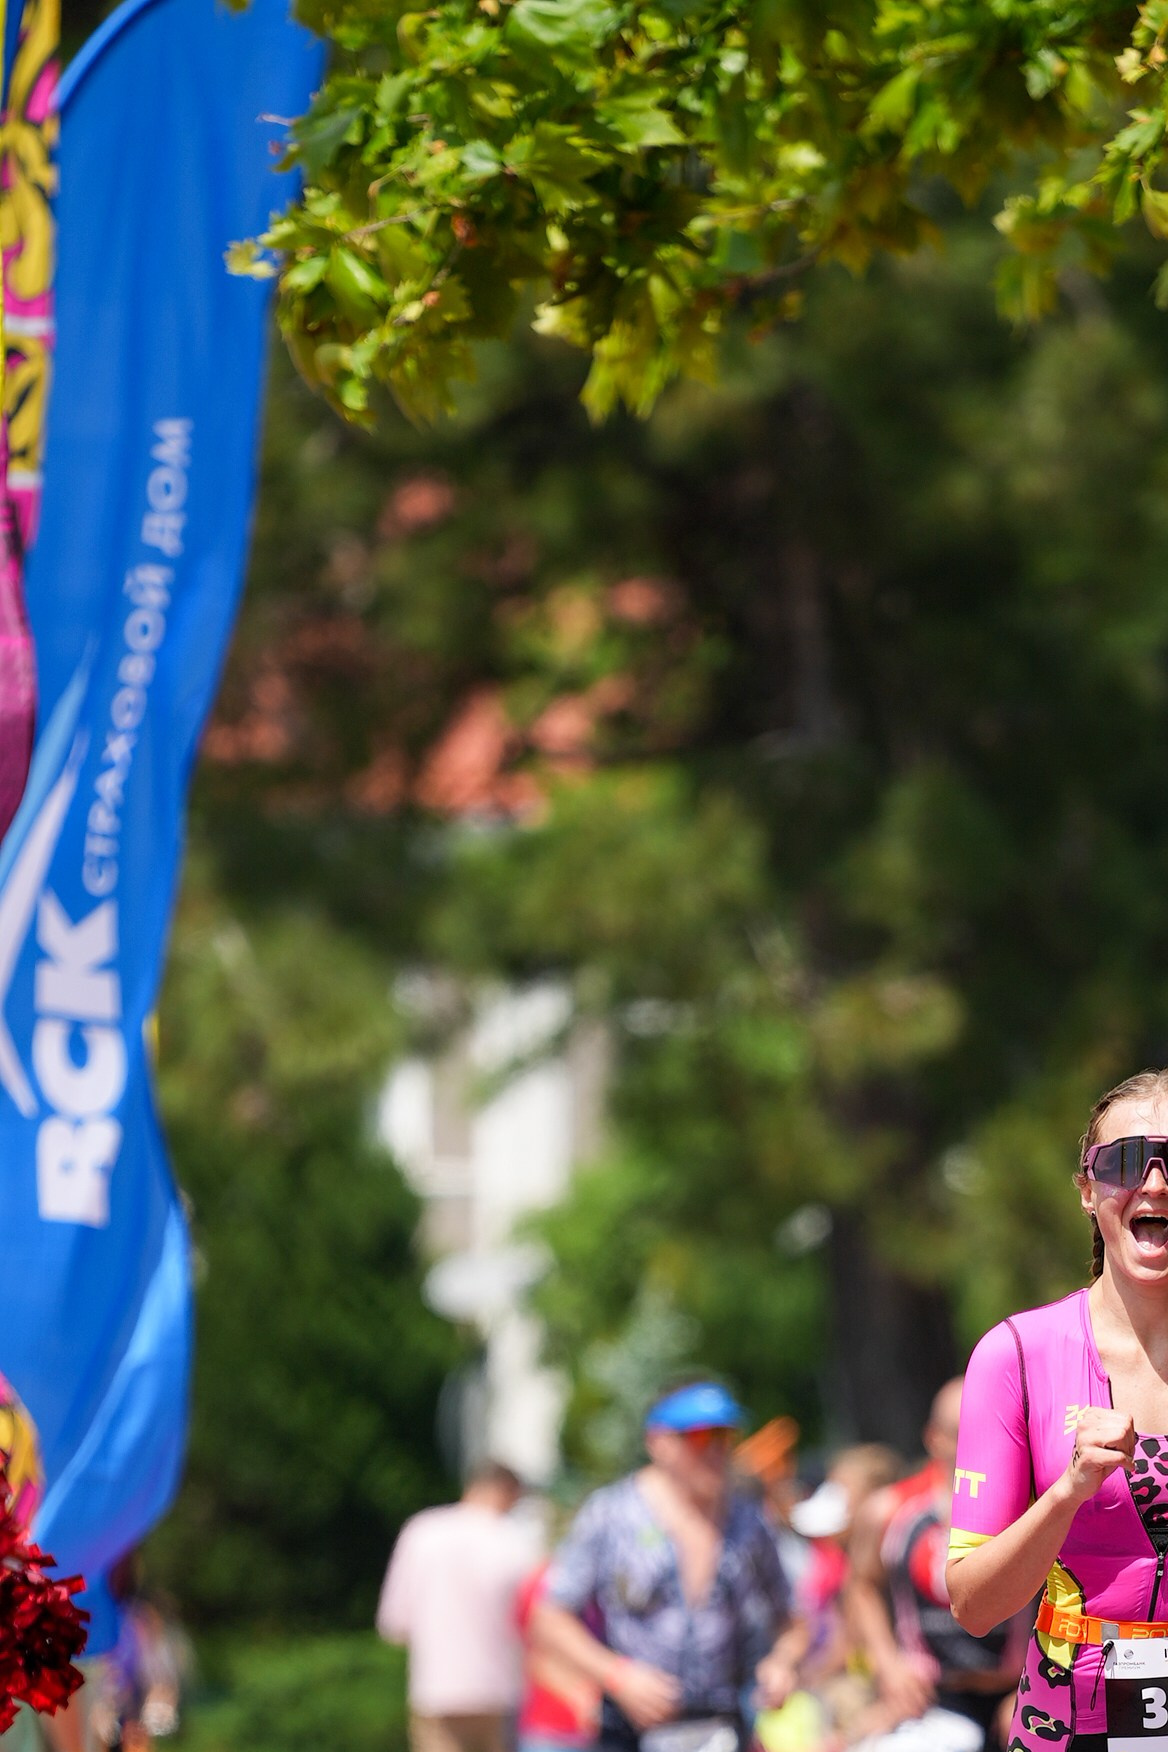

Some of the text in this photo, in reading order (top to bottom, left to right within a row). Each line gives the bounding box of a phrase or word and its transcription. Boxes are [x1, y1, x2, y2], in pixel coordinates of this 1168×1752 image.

[82, 417, 192, 898] СТРАХОВОЙ ДОМ
[32, 887, 128, 1228] ВСК
[954, 1468, 986, 1498] TT
